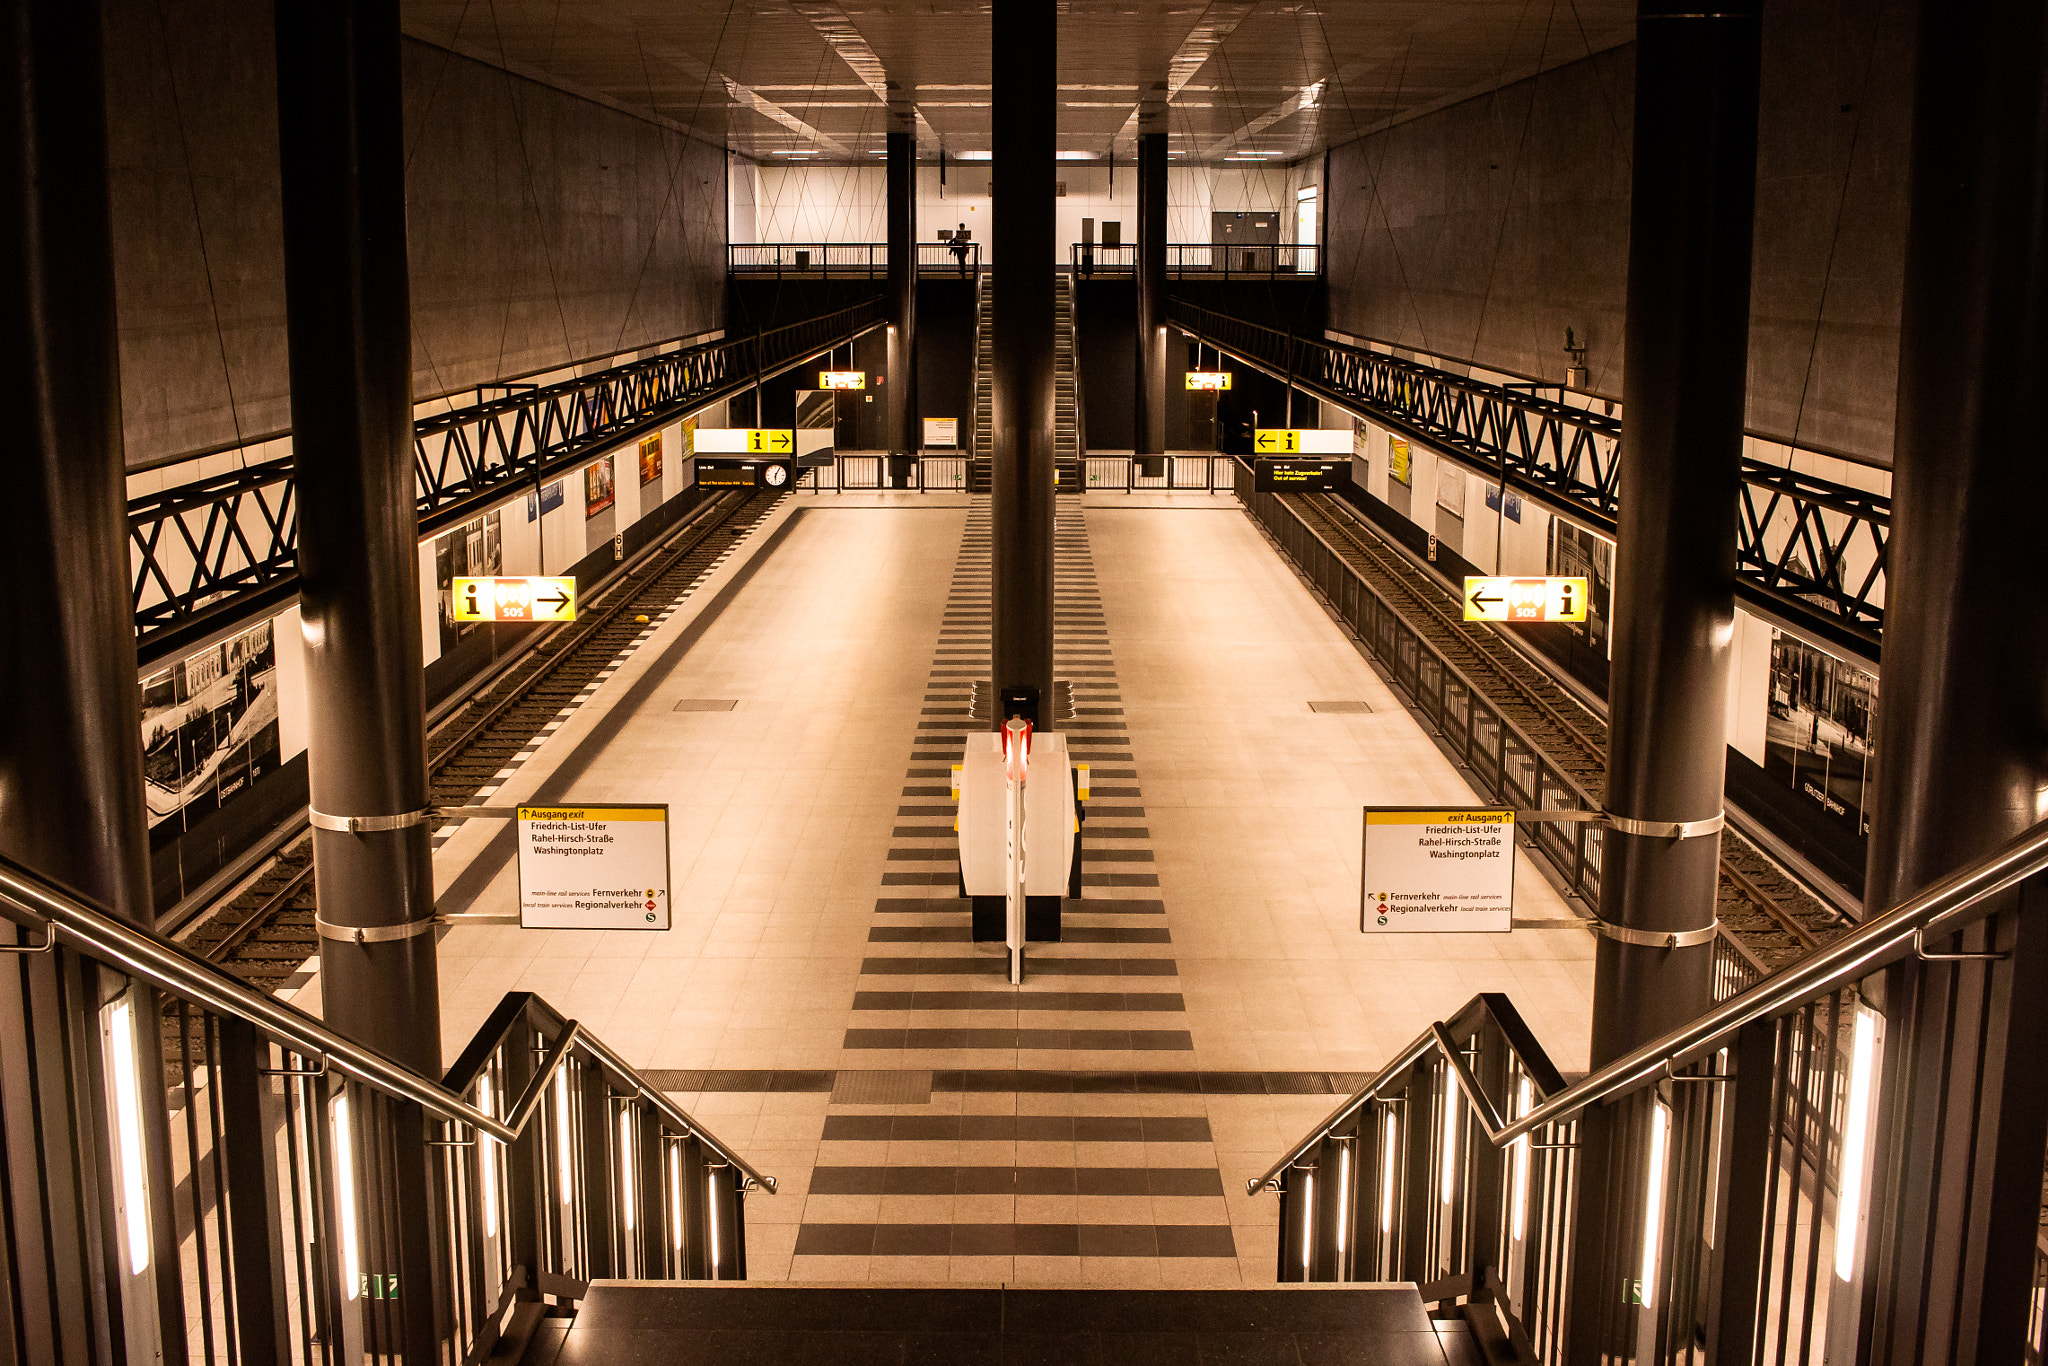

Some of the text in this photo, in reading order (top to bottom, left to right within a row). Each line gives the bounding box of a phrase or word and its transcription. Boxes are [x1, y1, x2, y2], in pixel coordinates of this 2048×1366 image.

[616, 534, 622, 544] 6
[1430, 535, 1435, 545] 6
[503, 608, 524, 617] SOS
[1516, 608, 1537, 617] SOS
[531, 810, 568, 820] Ausgang
[1466, 814, 1502, 823] Ausgang
[531, 822, 606, 830] Friedrich-List-Ufer
[1426, 825, 1501, 834] Friedrich-List-Ufer
[531, 834, 614, 843] Rahel-Hirsch-Straße
[1419, 837, 1501, 846] Rahel-Hirsch-Straße
[534, 846, 604, 856] Washingtonplatz
[1430, 850, 1500, 860] Washingtonplatz
[592, 889, 642, 897] Fernverkehr
[575, 901, 643, 910] Regionalverkehr
[1390, 905, 1458, 914] Regionalverkehr
